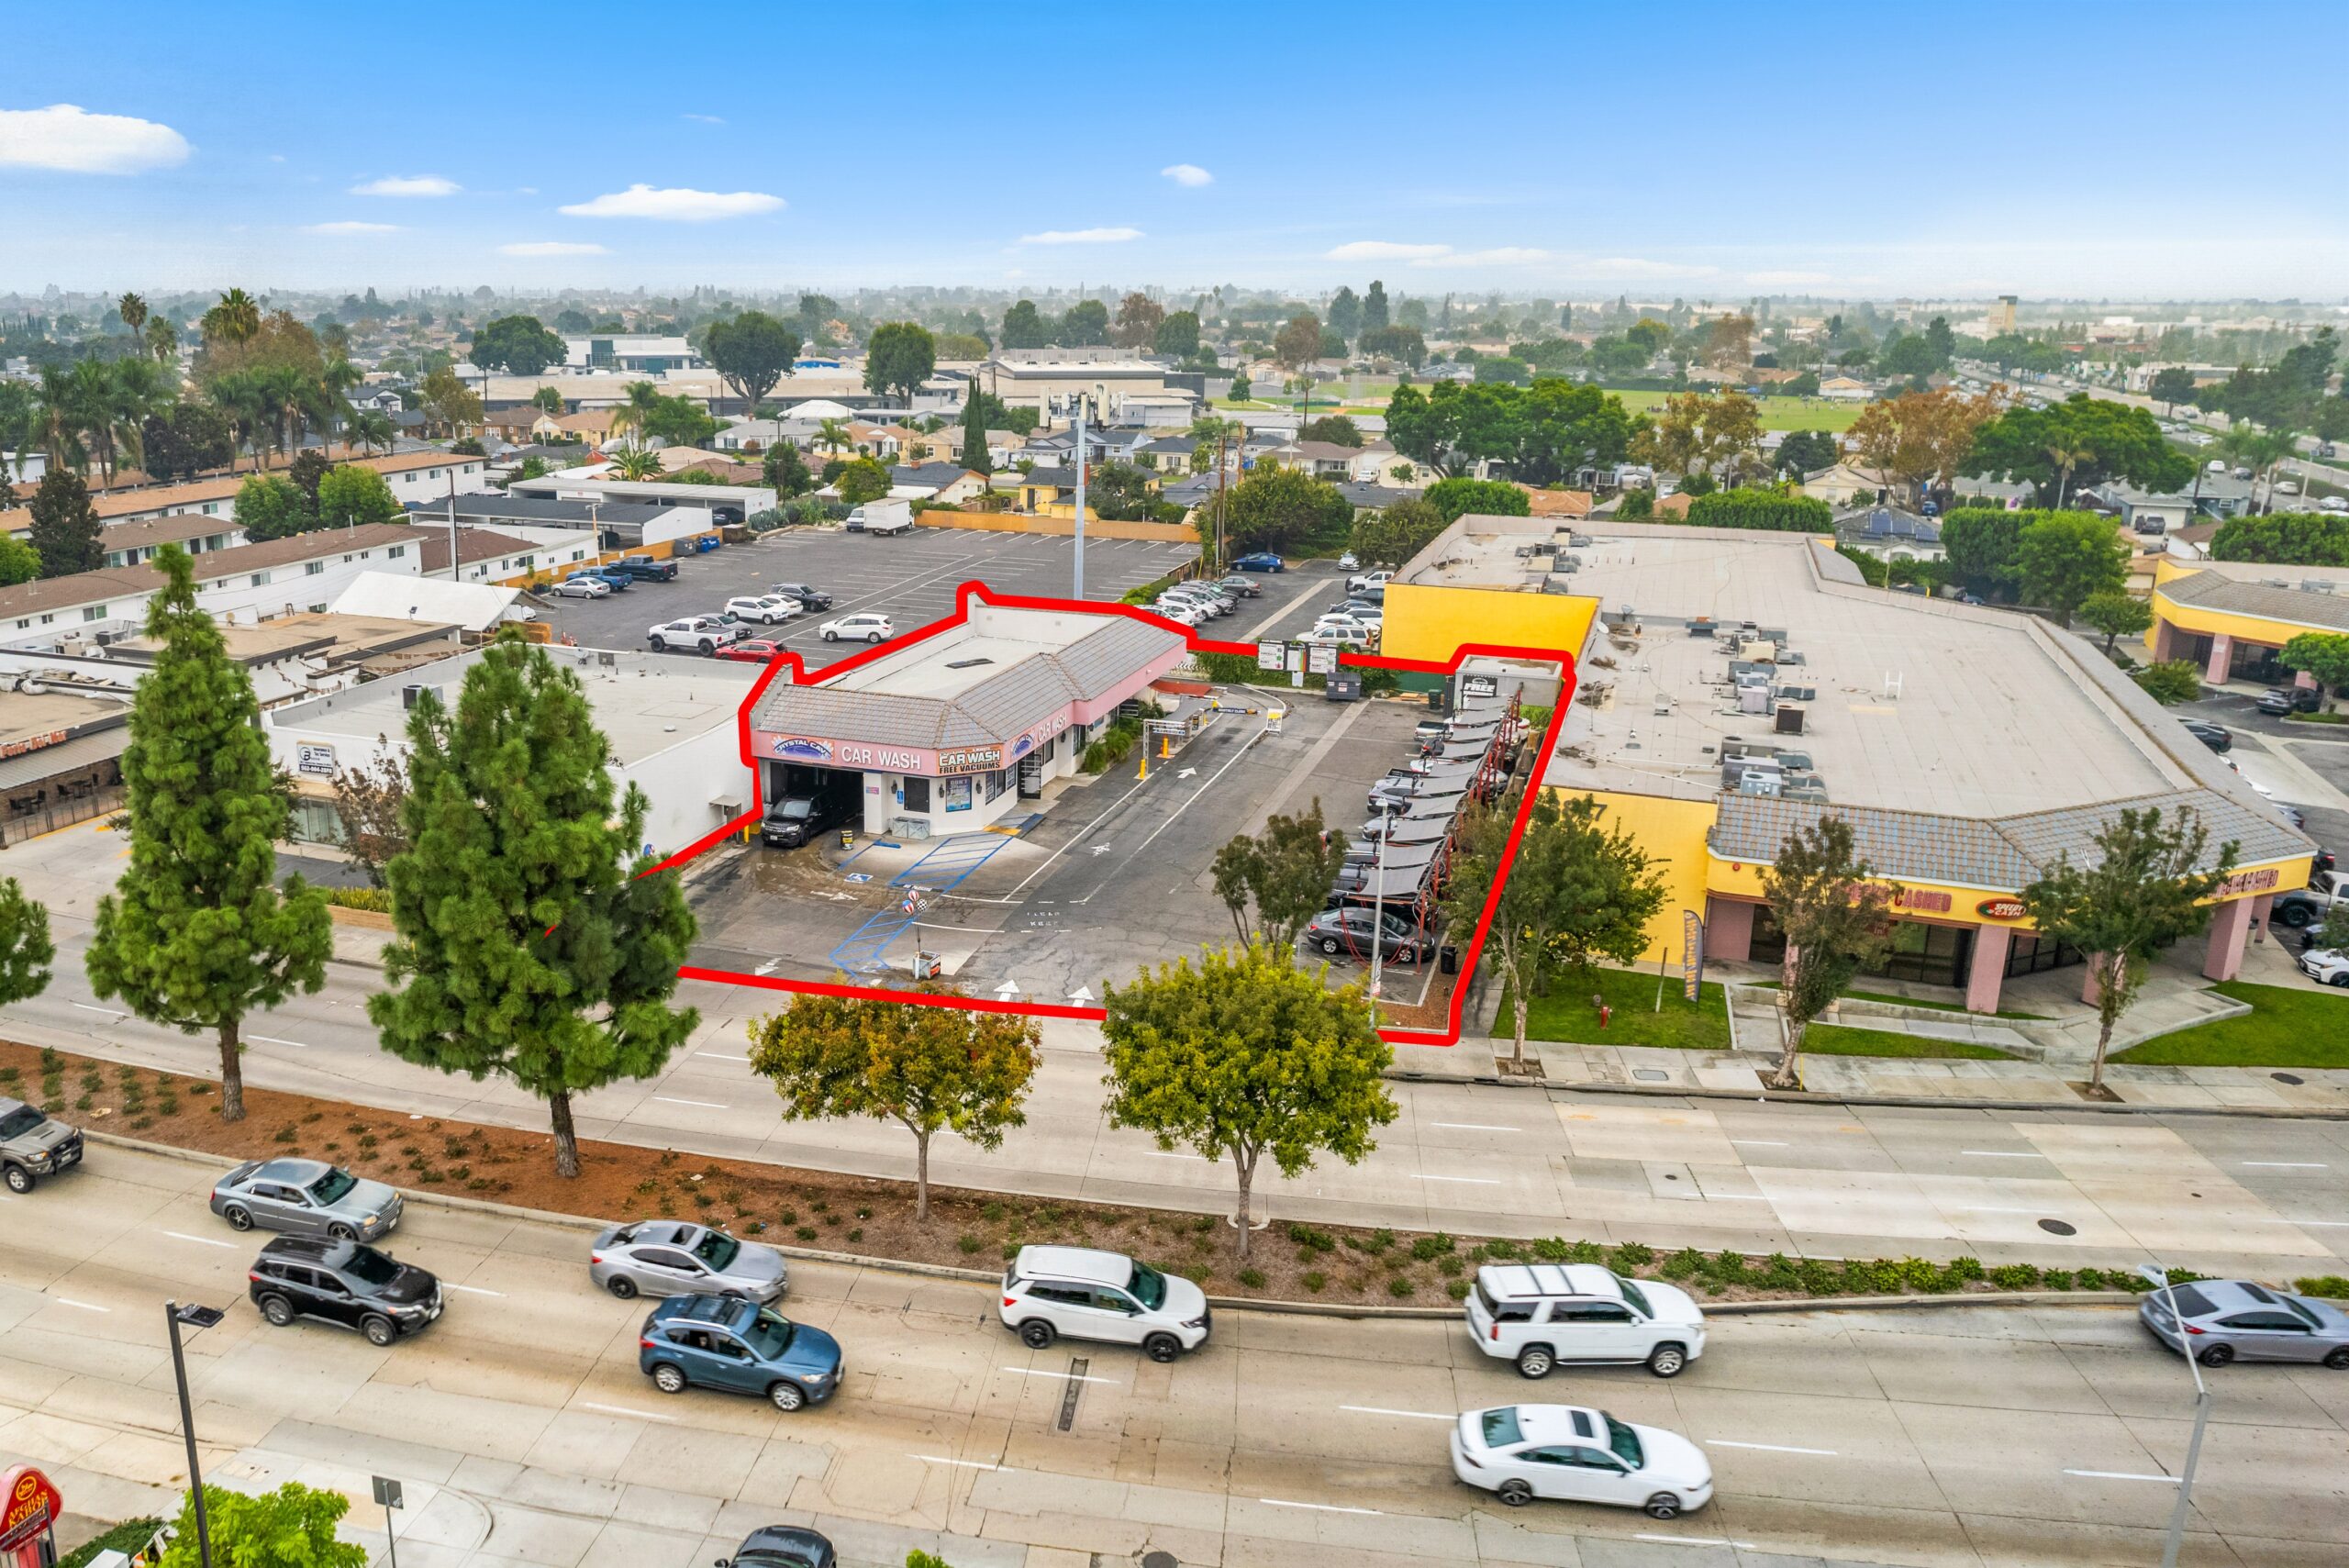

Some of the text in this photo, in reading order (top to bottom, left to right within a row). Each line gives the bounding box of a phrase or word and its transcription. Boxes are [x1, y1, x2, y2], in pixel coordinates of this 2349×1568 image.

[1038, 710, 1067, 742] CAR WASH
[774, 740, 808, 753] CRYSTAL
[841, 746, 921, 770] CAR WASH
[940, 752, 966, 767] CAR
[966, 750, 1000, 764] WASH
[940, 762, 1000, 774] FREE VACUUMS
[1894, 887, 1953, 912] CASHED
[1995, 903, 2024, 911] SPEEDY
[1994, 907, 2021, 917] CASH
